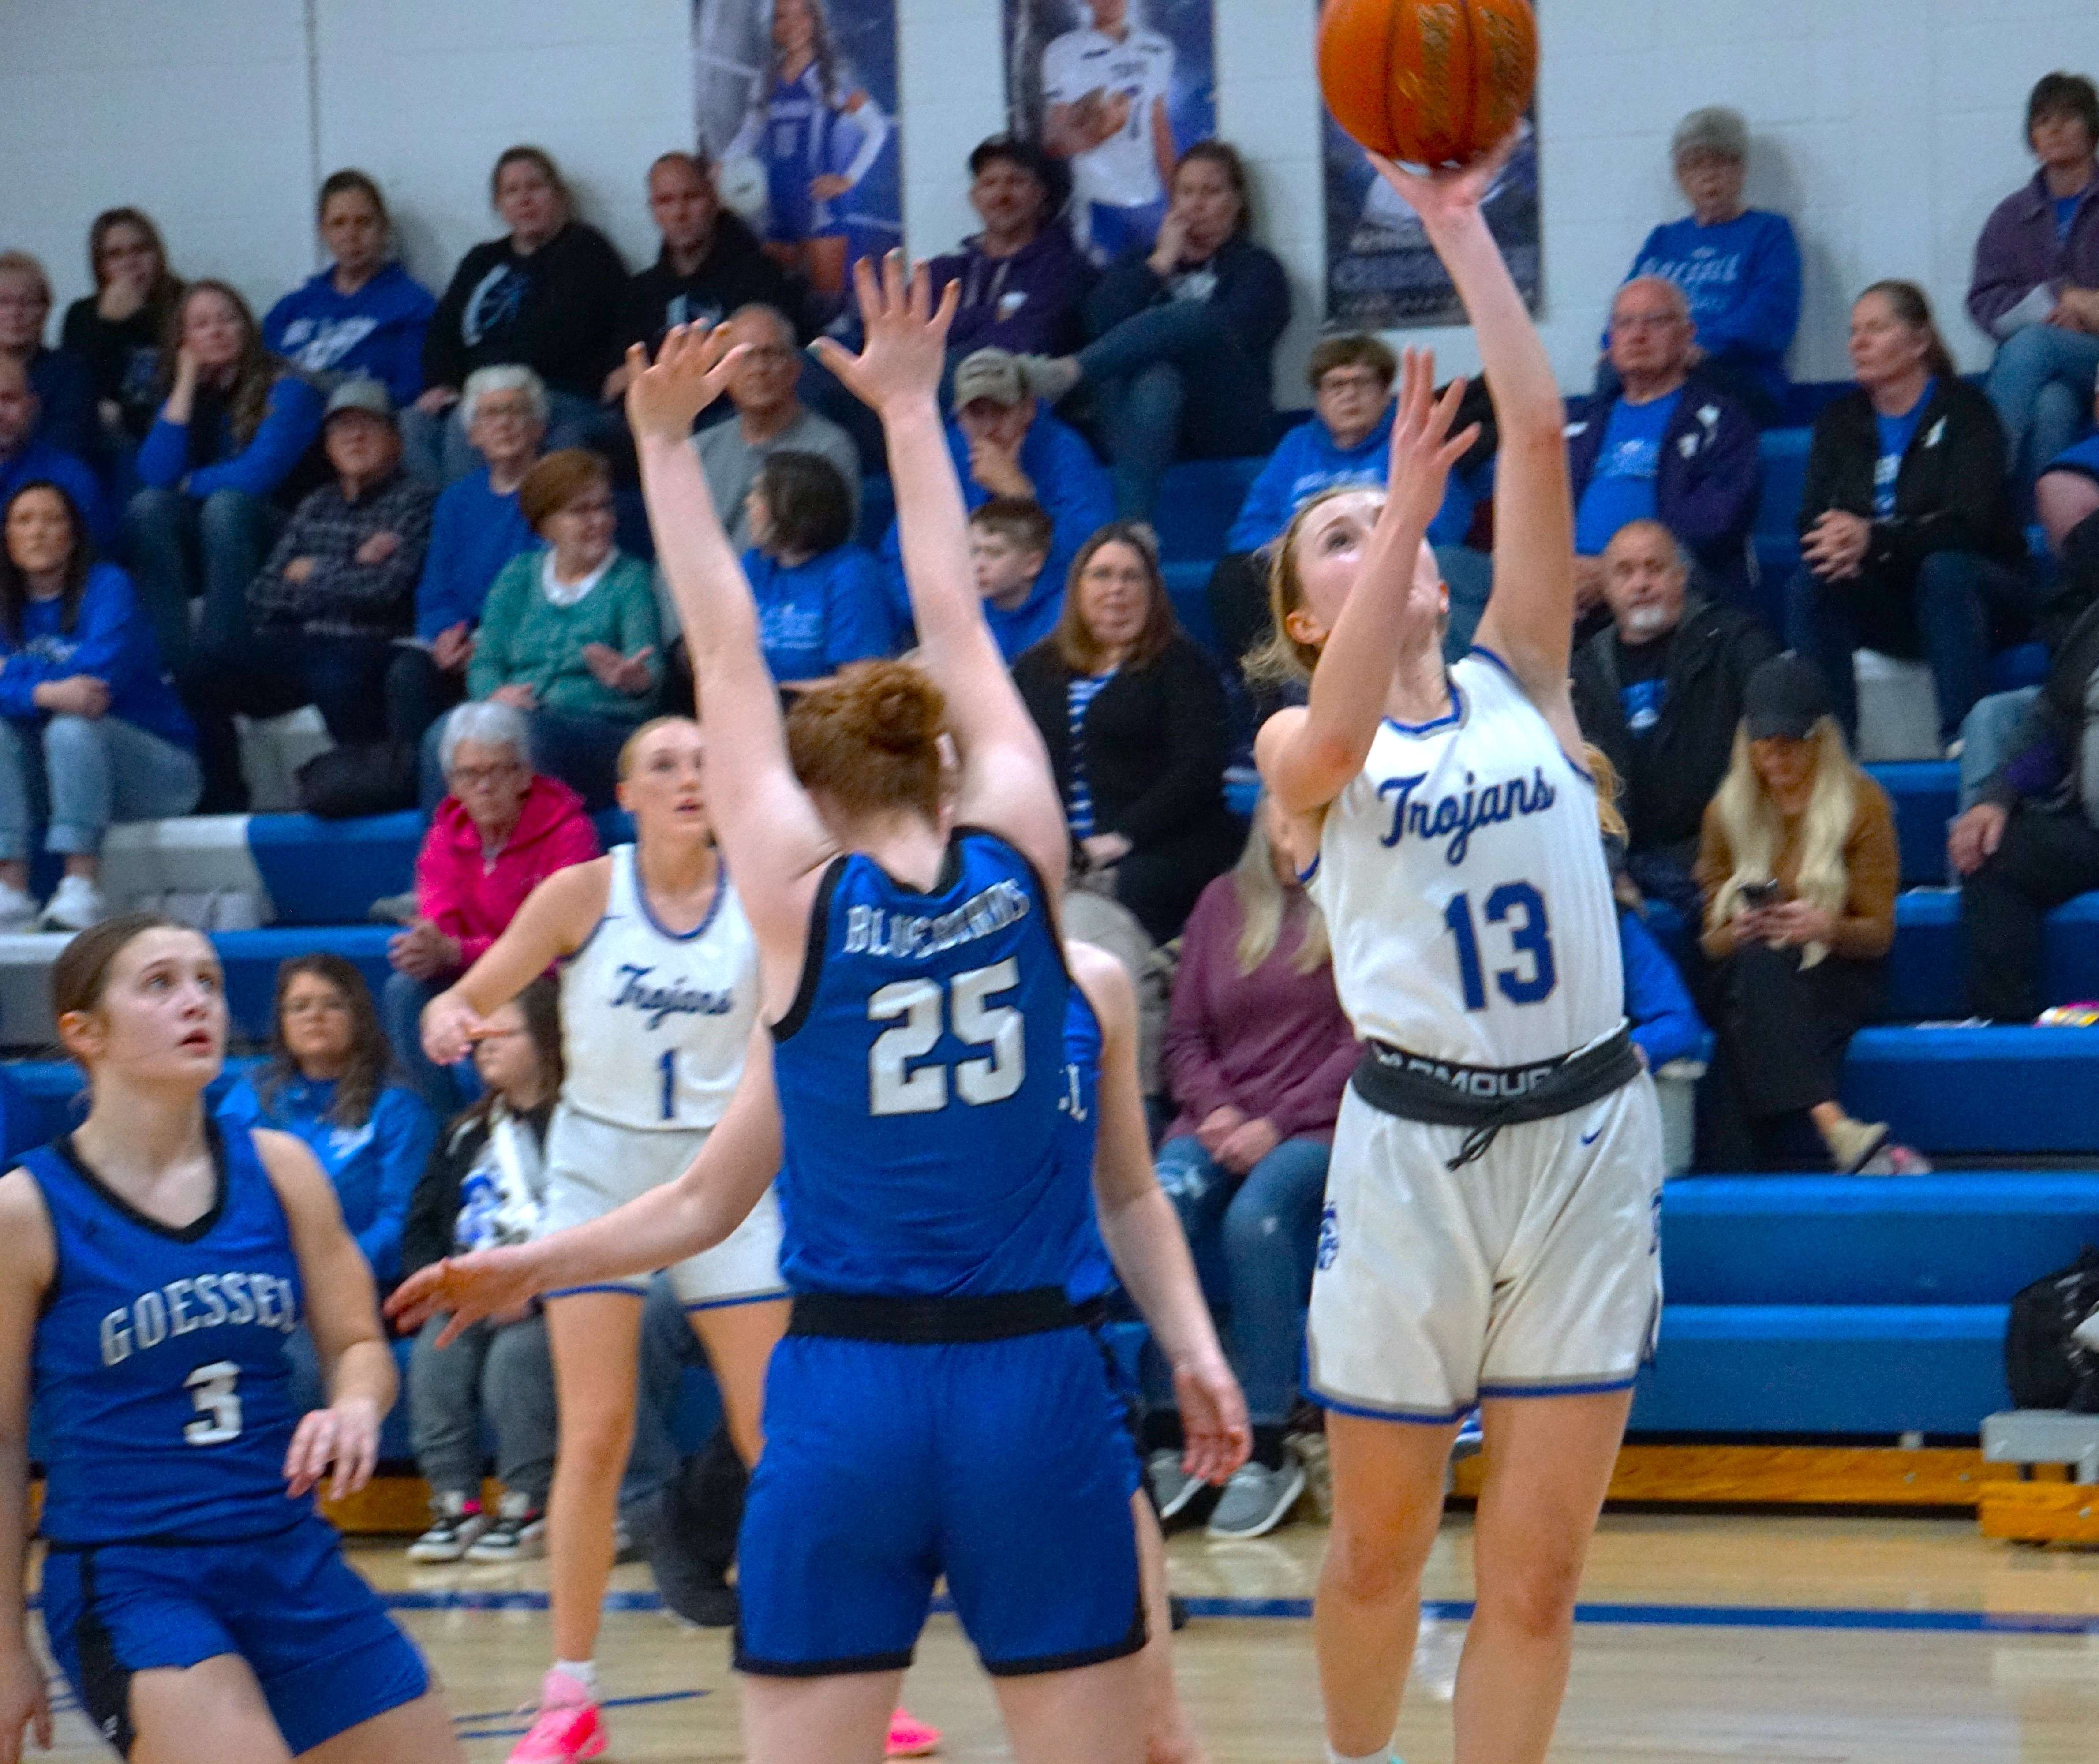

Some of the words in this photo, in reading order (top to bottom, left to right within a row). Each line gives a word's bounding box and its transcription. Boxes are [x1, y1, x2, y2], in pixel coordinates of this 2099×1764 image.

[1377, 766, 1556, 866] Trojans
[842, 878, 1030, 959] BLUES
[1443, 879, 1558, 1011] 13
[656, 1047, 678, 1120] 1
[867, 955, 1026, 1117] 25
[100, 1271, 296, 1367] GOESSEL
[182, 1360, 242, 1446] 3
